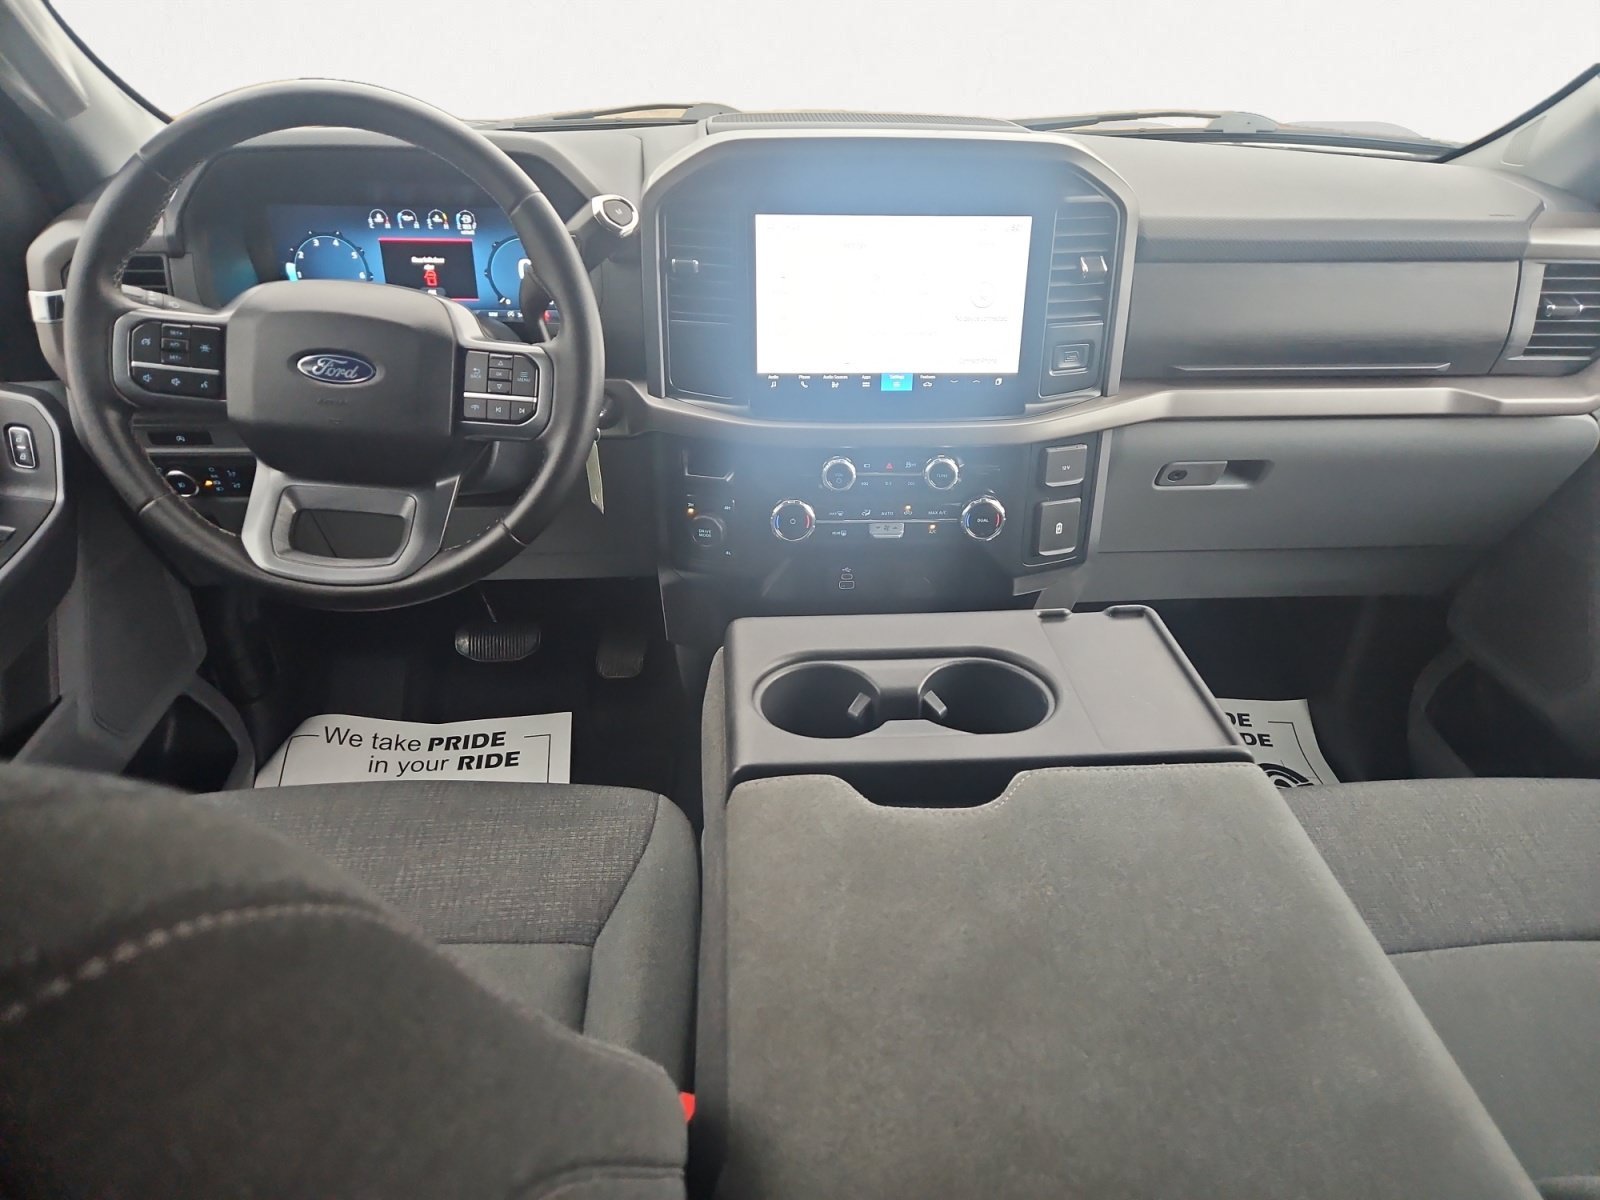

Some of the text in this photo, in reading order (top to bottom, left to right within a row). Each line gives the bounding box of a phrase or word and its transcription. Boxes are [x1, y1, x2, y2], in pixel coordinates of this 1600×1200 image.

[313, 239, 319, 247] 3
[332, 239, 340, 247] 4
[297, 251, 304, 259] 2
[351, 251, 358, 259] 5
[312, 357, 360, 379] Ford
[324, 726, 507, 752] We take PRIDE
[368, 751, 521, 777] in your RIDE
